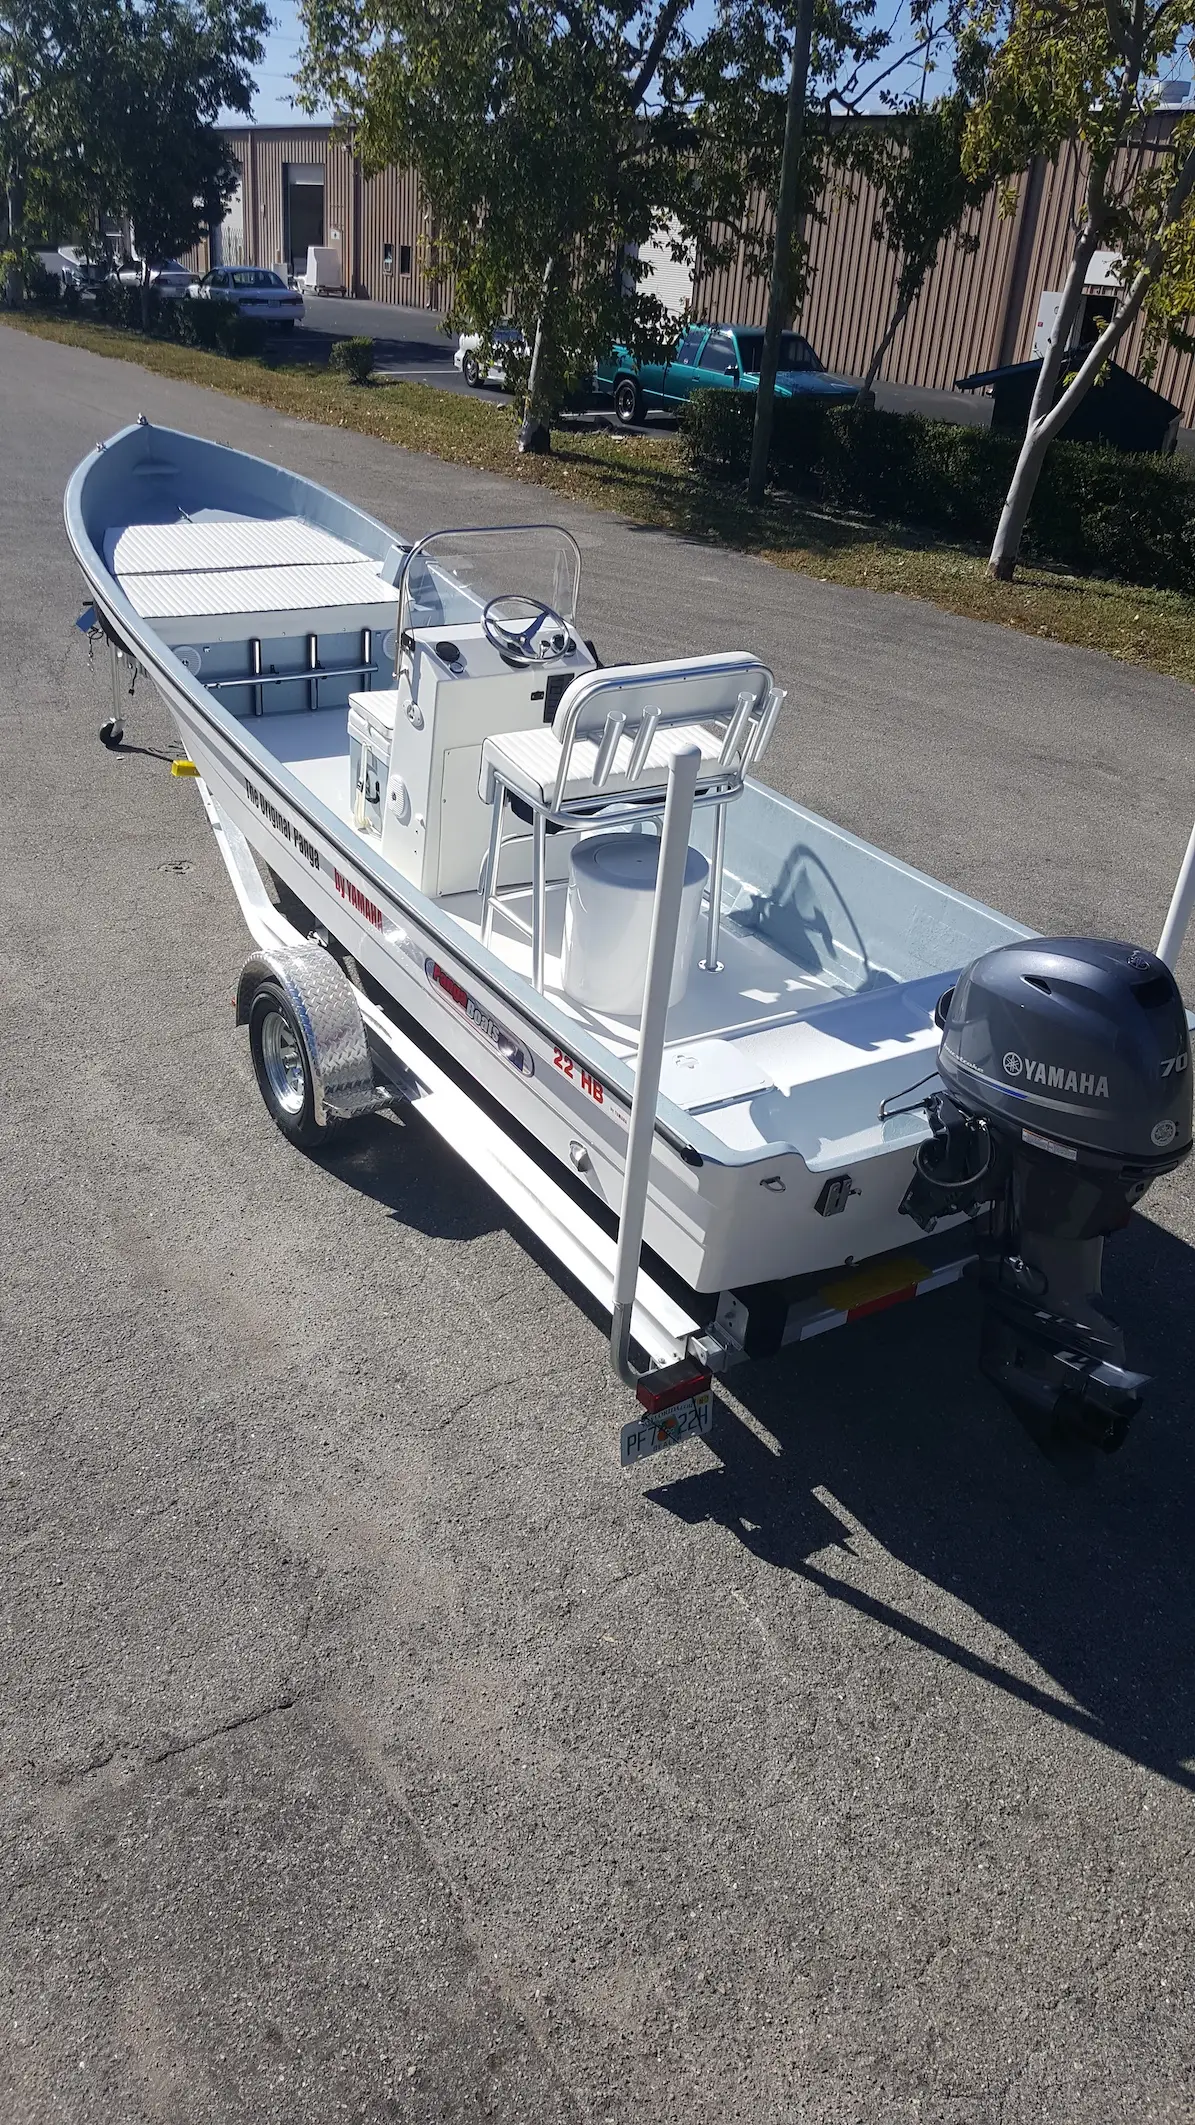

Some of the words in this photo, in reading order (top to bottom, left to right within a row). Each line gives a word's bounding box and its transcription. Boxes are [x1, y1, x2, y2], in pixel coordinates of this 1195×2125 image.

[244, 776, 260, 809] The
[259, 793, 291, 842] Original
[293, 827, 320, 870] Panga
[333, 866, 346, 899] by
[346, 879, 384, 934] YAMAHA
[432, 962, 468, 1009] Panga
[465, 998, 501, 1044] Boats
[553, 1046, 574, 1080] 22
[581, 1069, 605, 1105] HB
[1024, 1058, 1110, 1098] YAMAHA
[1159, 1052, 1189, 1078] 70
